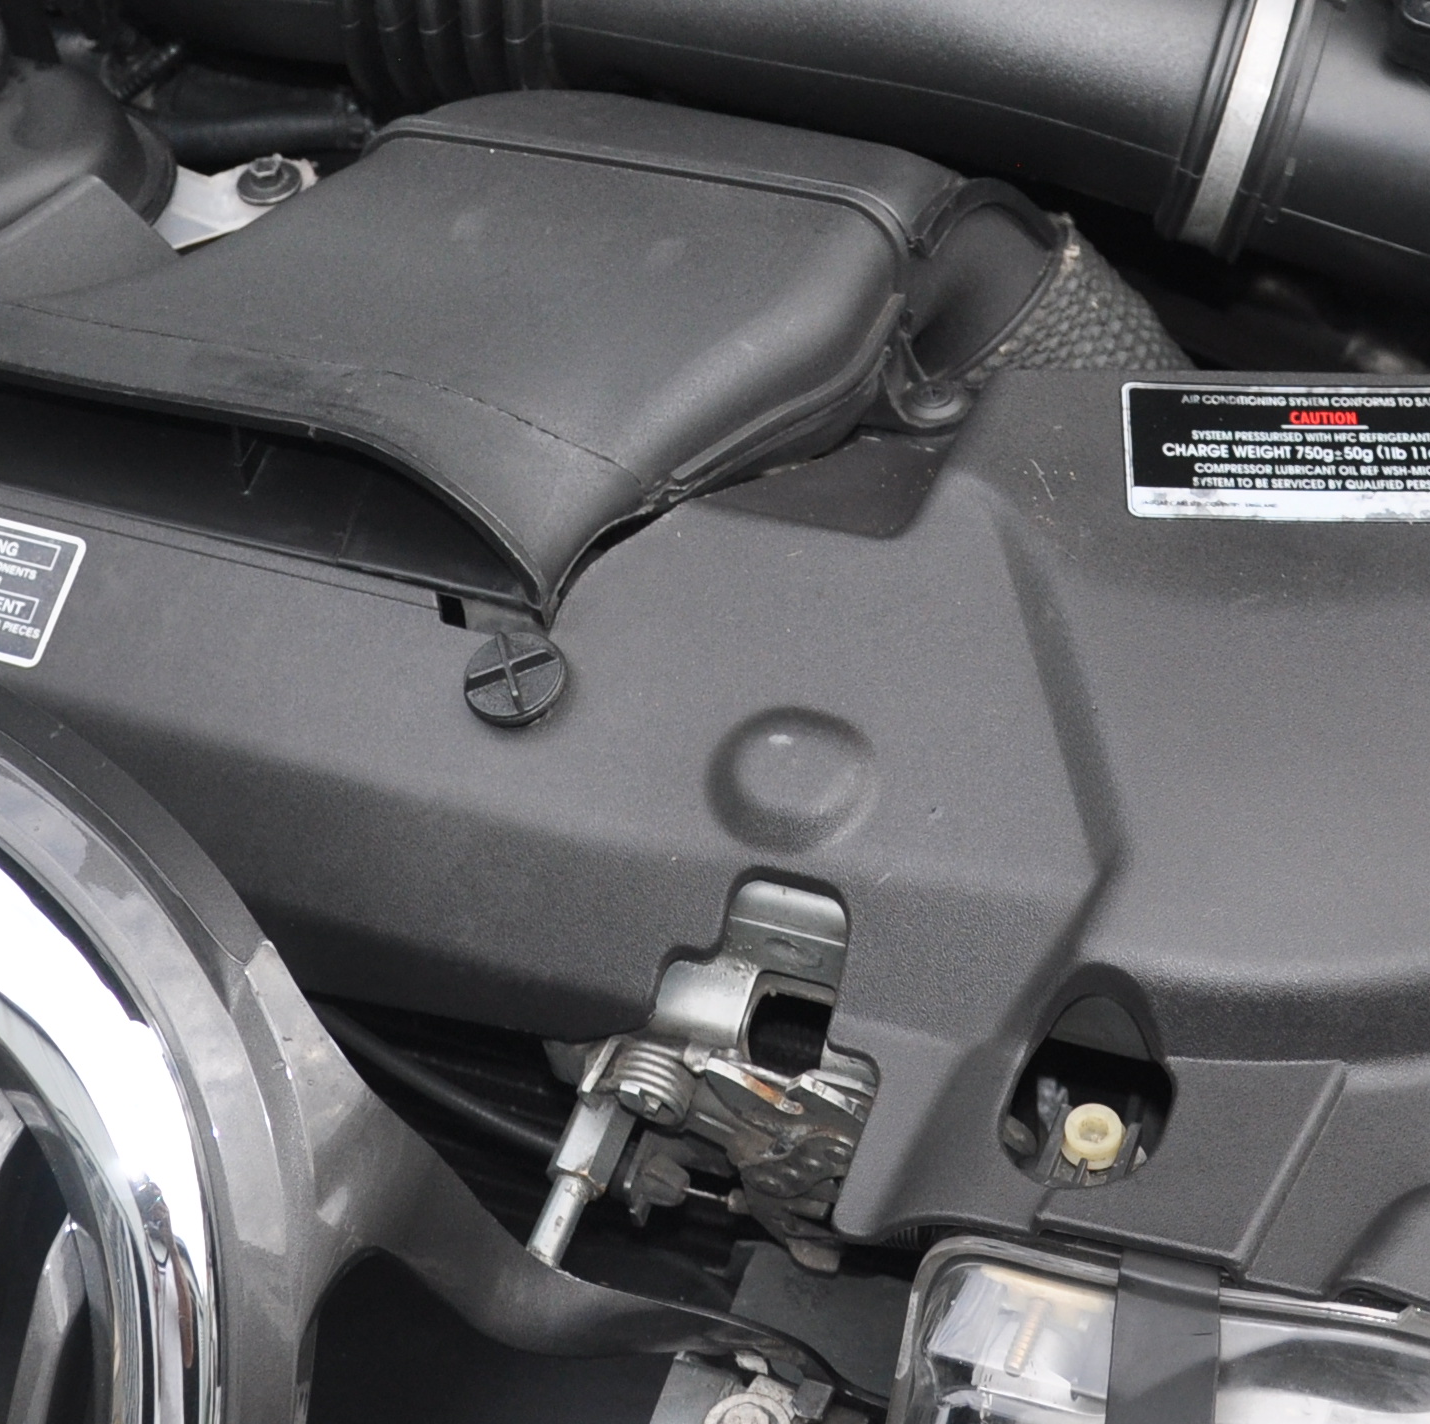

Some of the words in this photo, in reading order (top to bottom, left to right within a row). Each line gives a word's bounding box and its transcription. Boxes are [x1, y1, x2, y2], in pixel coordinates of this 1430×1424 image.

[1181, 394, 1200, 405] AIR
[1202, 395, 1287, 407] CONDITIONING
[1289, 396, 1330, 407] SYSTEM
[1331, 397, 1396, 408] CONFORMS
[1398, 397, 1413, 407] TO
[1289, 410, 1359, 425] CAUTION
[1191, 429, 1233, 441] SYSTEM
[1234, 431, 1303, 442] PRESSURISED
[1304, 432, 1332, 442] WITH
[1334, 432, 1357, 443] HFC
[1359, 432, 1430, 443] REFRIGERANT
[1162, 442, 1230, 458] CHARGE
[1232, 444, 1292, 459] WEIGHT
[1194, 463, 1273, 474] COMPRESSOR
[1274, 464, 1337, 475] LUBRICANT
[1338, 465, 1358, 476] OIL
[1360, 466, 1379, 476] REF
[1192, 476, 1235, 487] SYSTEM
[1237, 477, 1253, 488] TO
[1255, 478, 1269, 488] BE
[1271, 478, 1326, 489] SERVICED
[1328, 479, 1343, 489] BY
[1345, 479, 1404, 490] QUALIFIED
